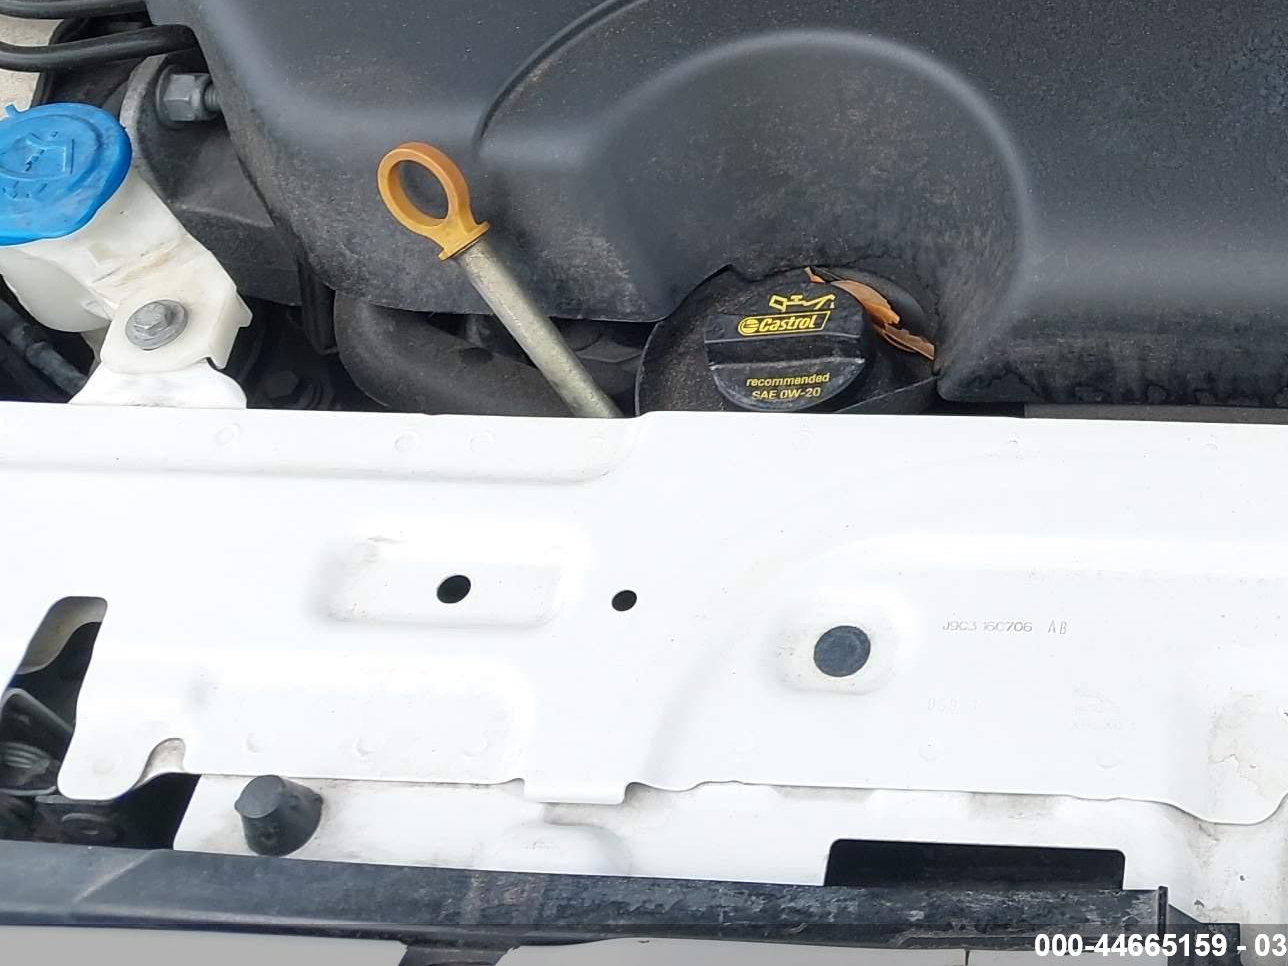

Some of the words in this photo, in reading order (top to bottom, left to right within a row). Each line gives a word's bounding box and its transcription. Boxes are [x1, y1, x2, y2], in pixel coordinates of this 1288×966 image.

[758, 314, 818, 332] Castrol
[746, 373, 831, 388] recommended
[751, 390, 777, 401] SAE
[779, 387, 821, 400] 0W-20
